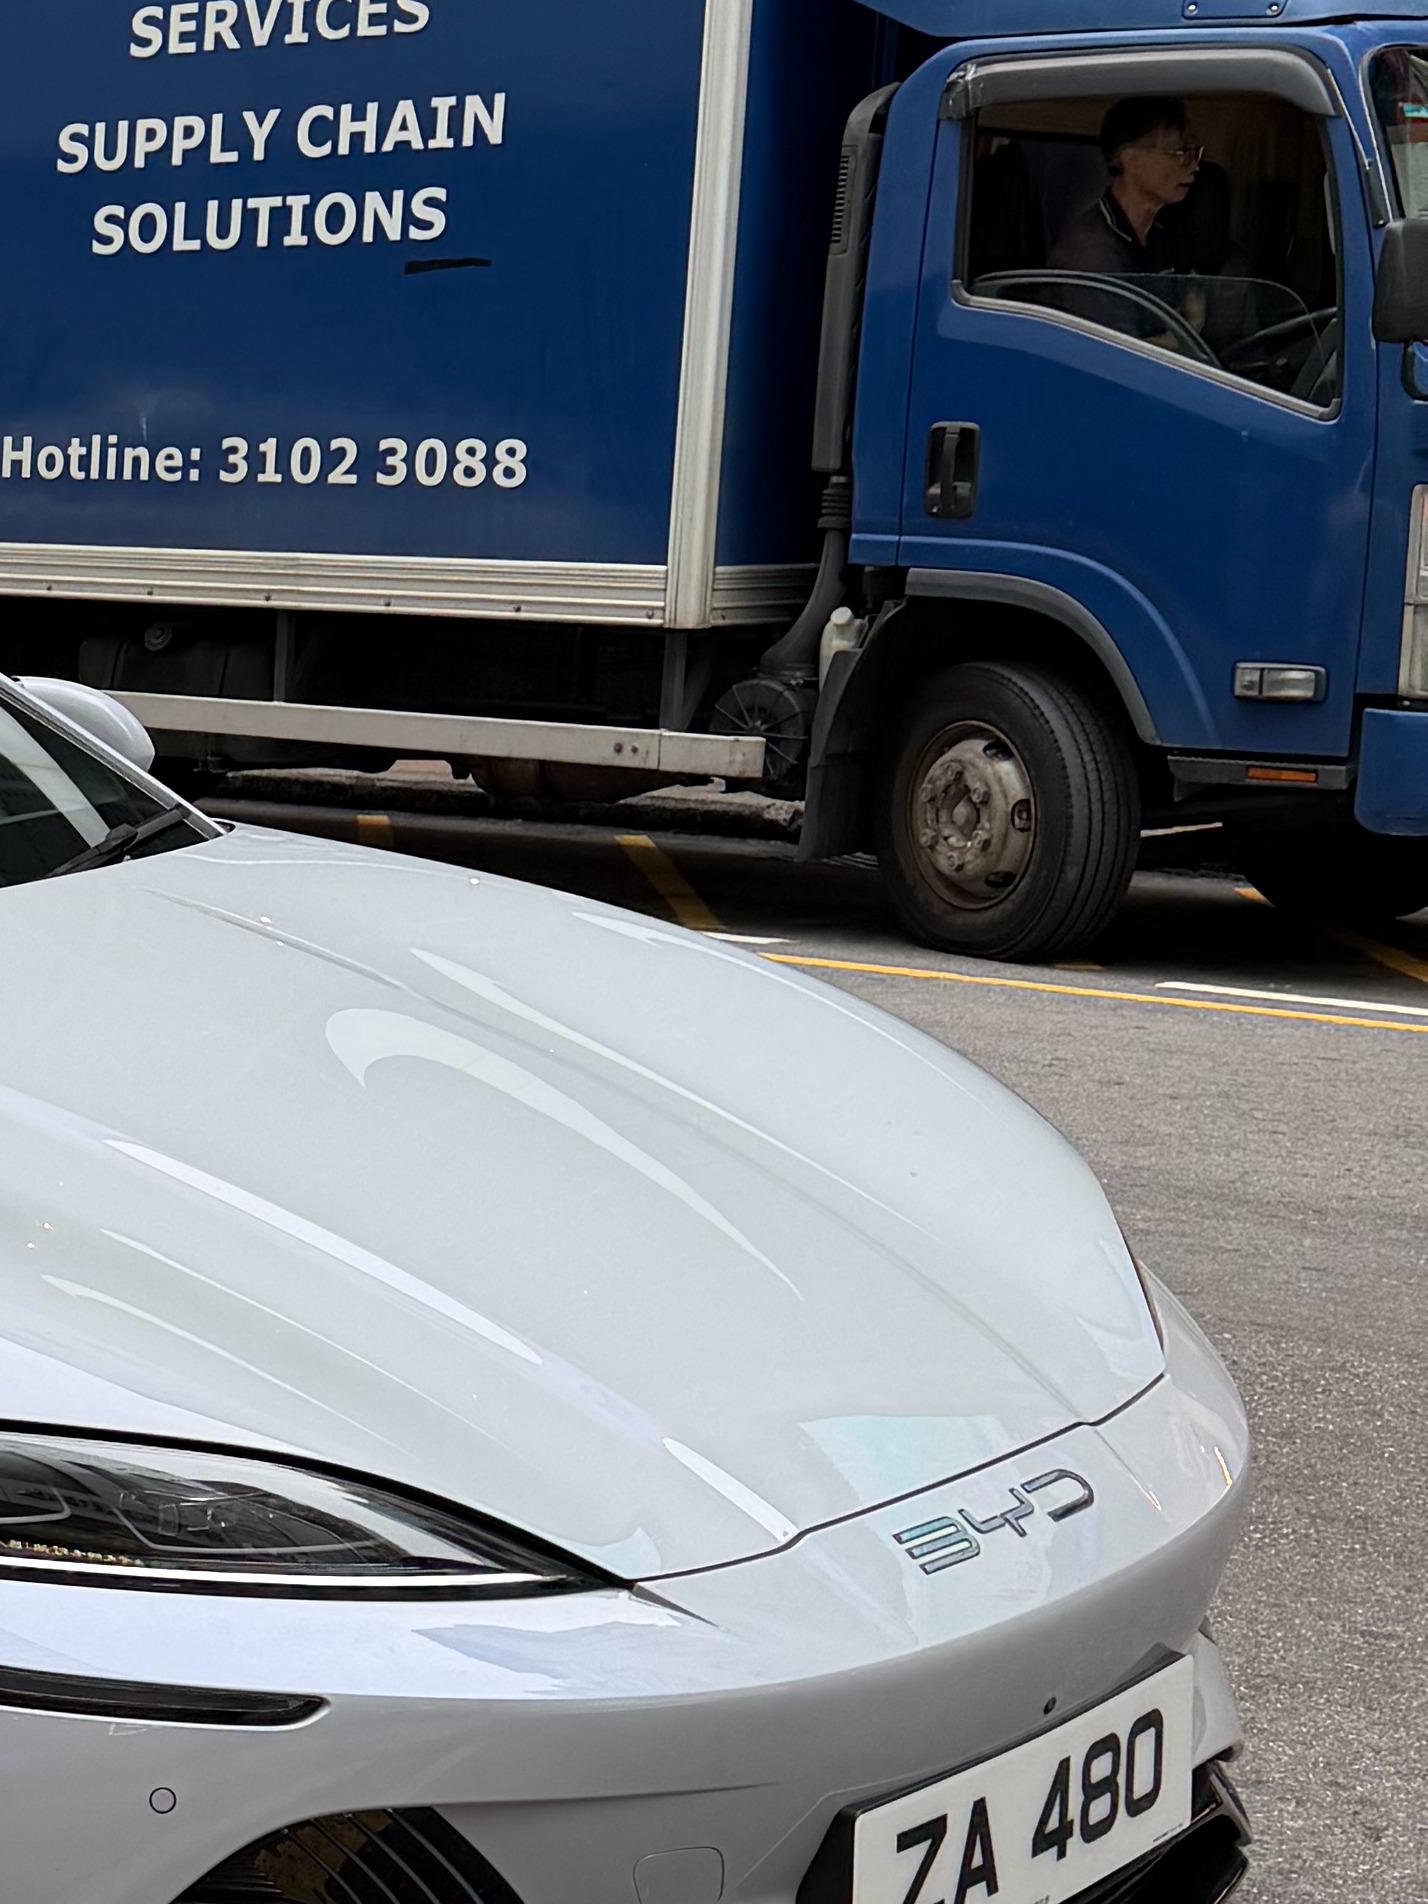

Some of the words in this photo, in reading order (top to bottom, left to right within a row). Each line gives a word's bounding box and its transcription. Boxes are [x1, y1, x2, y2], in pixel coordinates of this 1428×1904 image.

[55, 109, 282, 176] SUPPLY
[296, 90, 507, 161] CHAIN
[91, 187, 449, 256] SOLUTIONS
[0, 436, 200, 484] Hotline:
[218, 438, 358, 486] 3102
[377, 440, 528, 488] 3088
[892, 1469, 1094, 1575] BYD
[1031, 1708, 1164, 1862] 480
